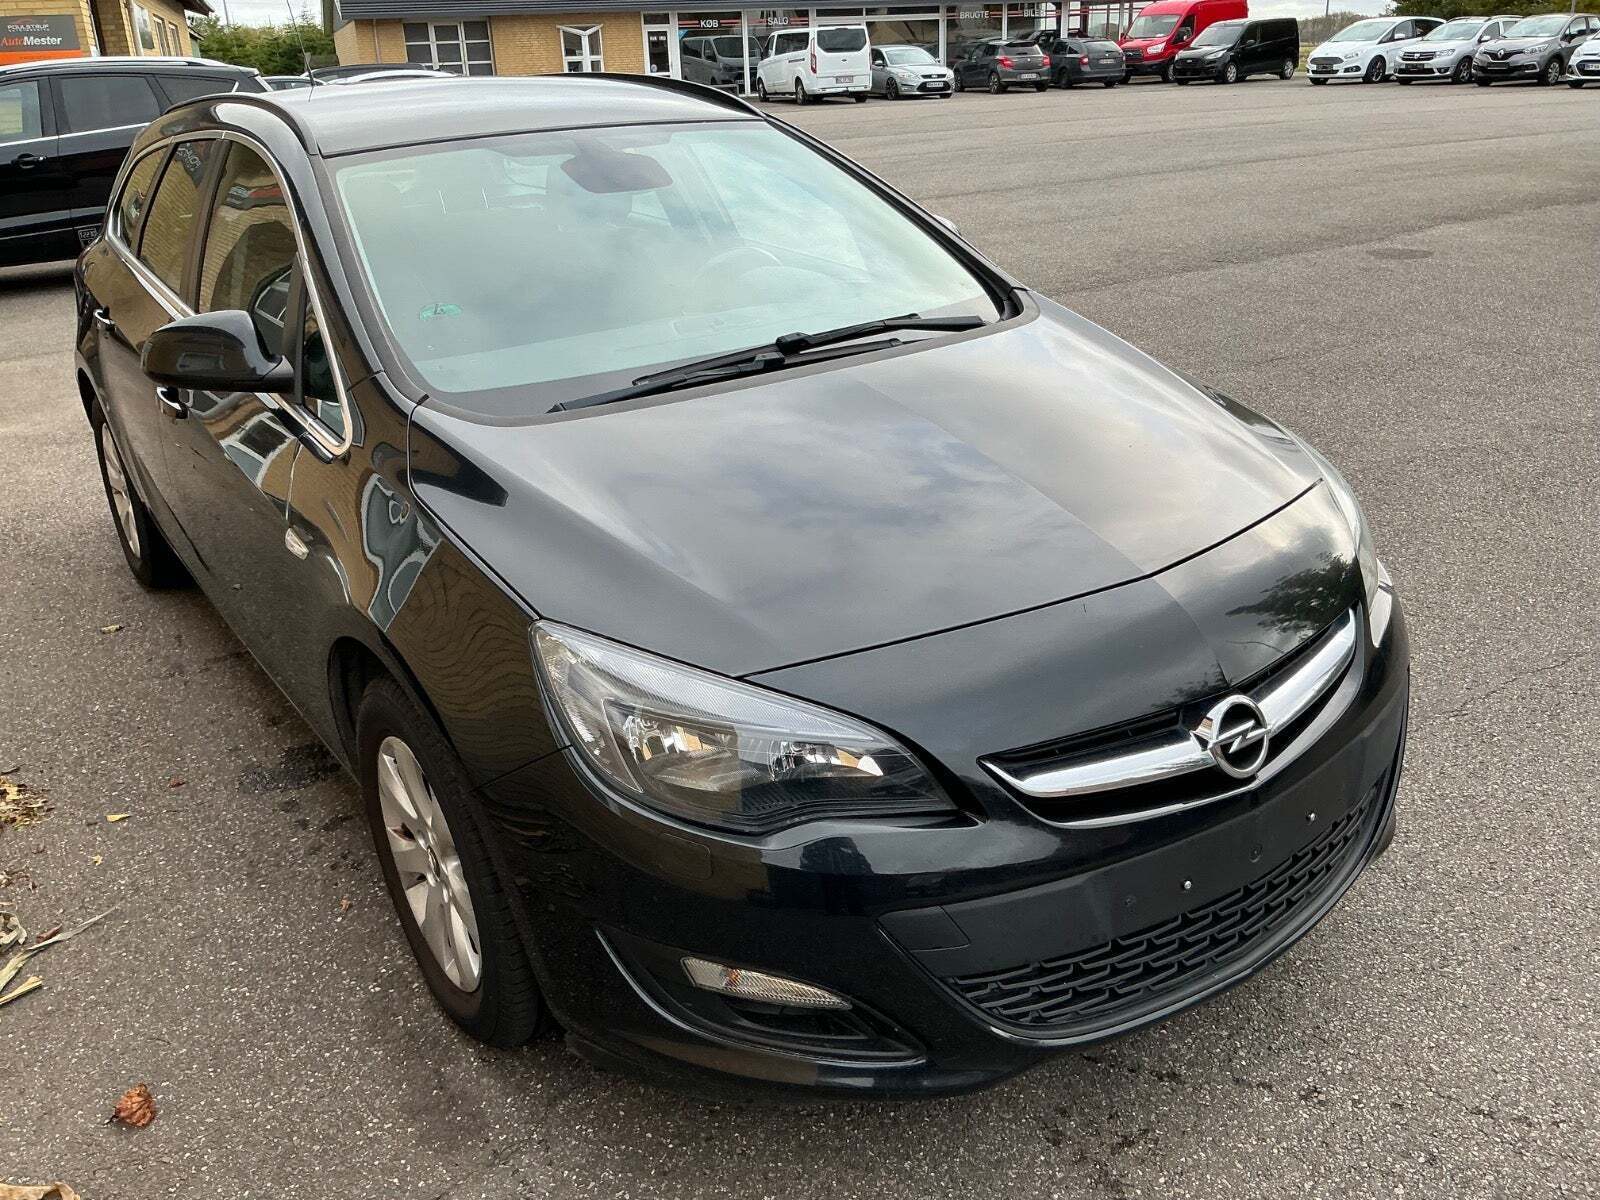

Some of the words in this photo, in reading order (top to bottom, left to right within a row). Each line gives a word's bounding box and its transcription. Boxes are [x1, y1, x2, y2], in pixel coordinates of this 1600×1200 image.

[959, 10, 990, 19] BRUGTE
[700, 19, 719, 28] KØB
[767, 16, 789, 25] SALG
[2, 36, 63, 46] AutoMester
